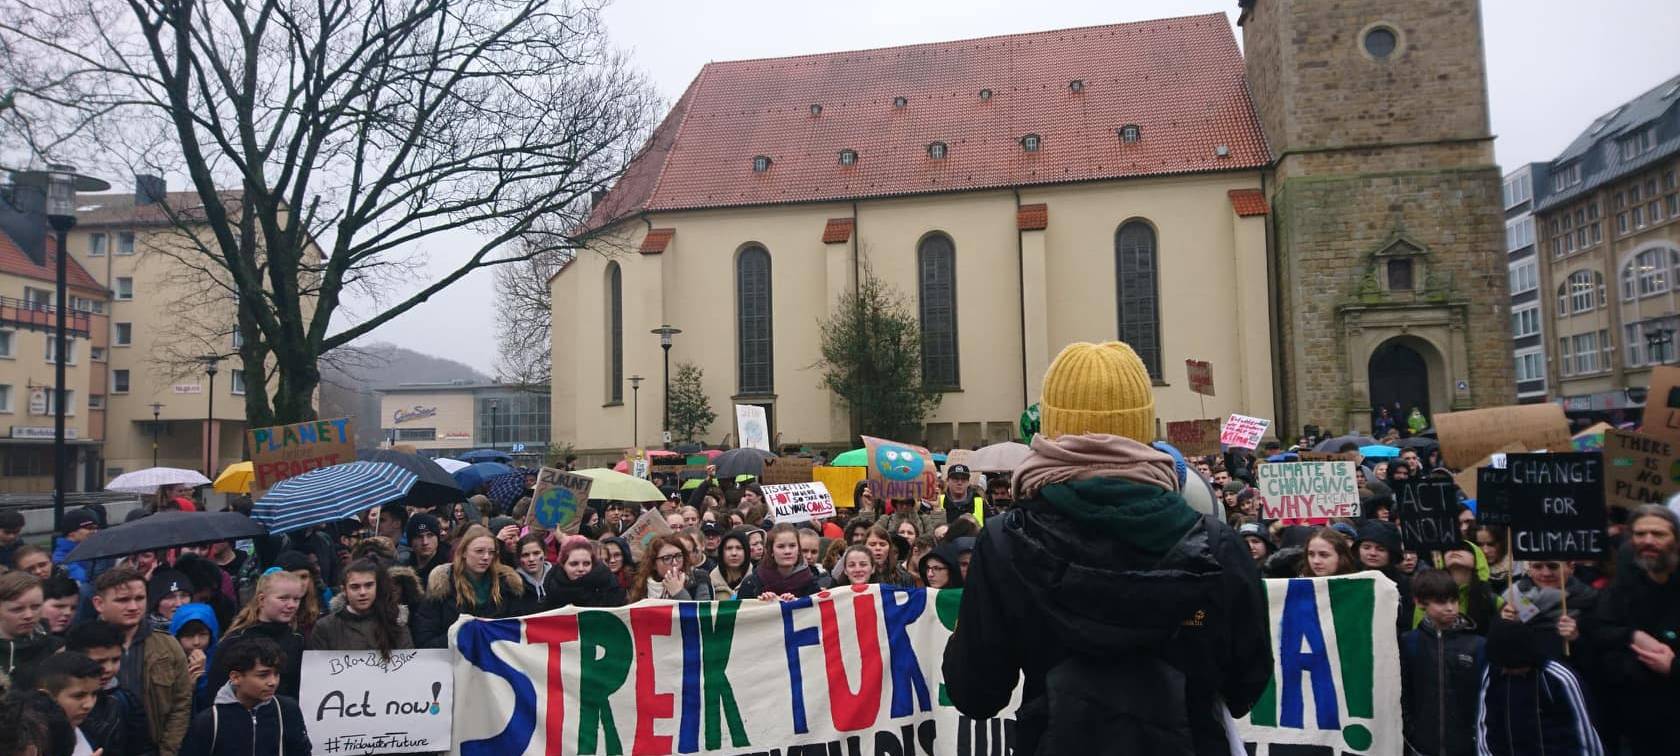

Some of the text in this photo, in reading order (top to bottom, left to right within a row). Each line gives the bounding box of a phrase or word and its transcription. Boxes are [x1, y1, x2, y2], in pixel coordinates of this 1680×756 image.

[254, 418, 350, 454] PLANET
[1615, 433, 1672, 456] THERE
[1260, 462, 1346, 478] CLIMATE IS
[1512, 460, 1597, 484] CHANGE
[1644, 456, 1658, 470] IS
[871, 471, 936, 500] PLANET B
[1268, 476, 1354, 496] CHANGING
[1637, 469, 1663, 486] NO
[769, 491, 791, 505] HOT
[775, 500, 833, 517] ALL YOUR COALS
[1261, 494, 1315, 518] WHY
[1403, 482, 1451, 512] ACT
[1543, 497, 1578, 516] FOR
[1319, 503, 1358, 516] WE?
[1405, 517, 1456, 544] NOW
[1517, 530, 1601, 553] CLIMATE
[329, 655, 364, 676] Bla
[457, 600, 751, 756] STREIK
[316, 681, 442, 721] Act now!
